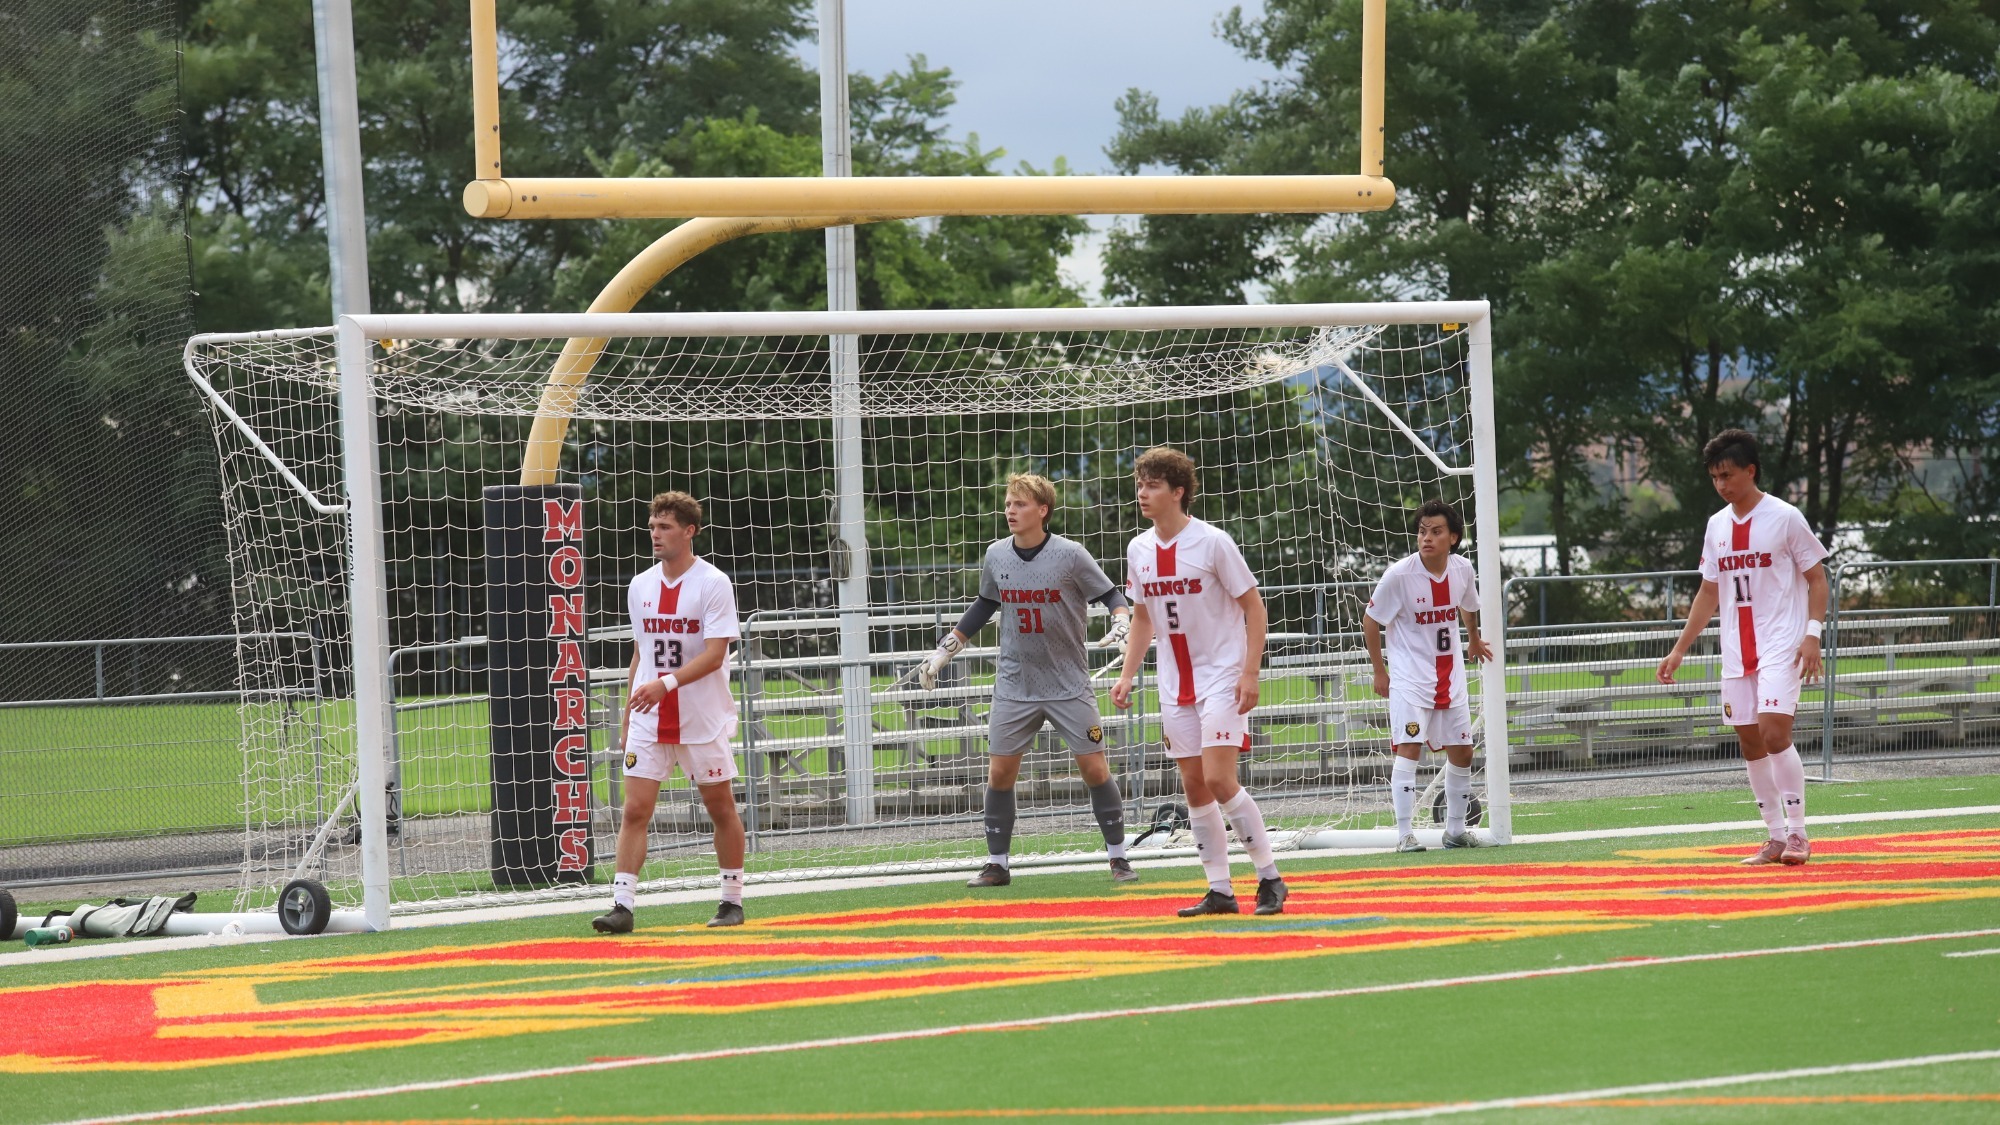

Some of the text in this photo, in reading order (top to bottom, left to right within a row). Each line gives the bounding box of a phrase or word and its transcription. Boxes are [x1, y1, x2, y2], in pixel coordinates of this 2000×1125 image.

[1718, 552, 1772, 572] KING'S
[1000, 588, 1061, 603] KING'S
[1142, 578, 1202, 597] KING'S
[1733, 575, 1752, 602] 11
[643, 618, 700, 634] KING'S
[1017, 608, 1044, 633] 31
[1166, 601, 1179, 630] 5
[1415, 606, 1459, 625] KING'
[1437, 627, 1450, 652] 6
[654, 639, 683, 668] 23
[542, 499, 589, 872] MONARCHS
